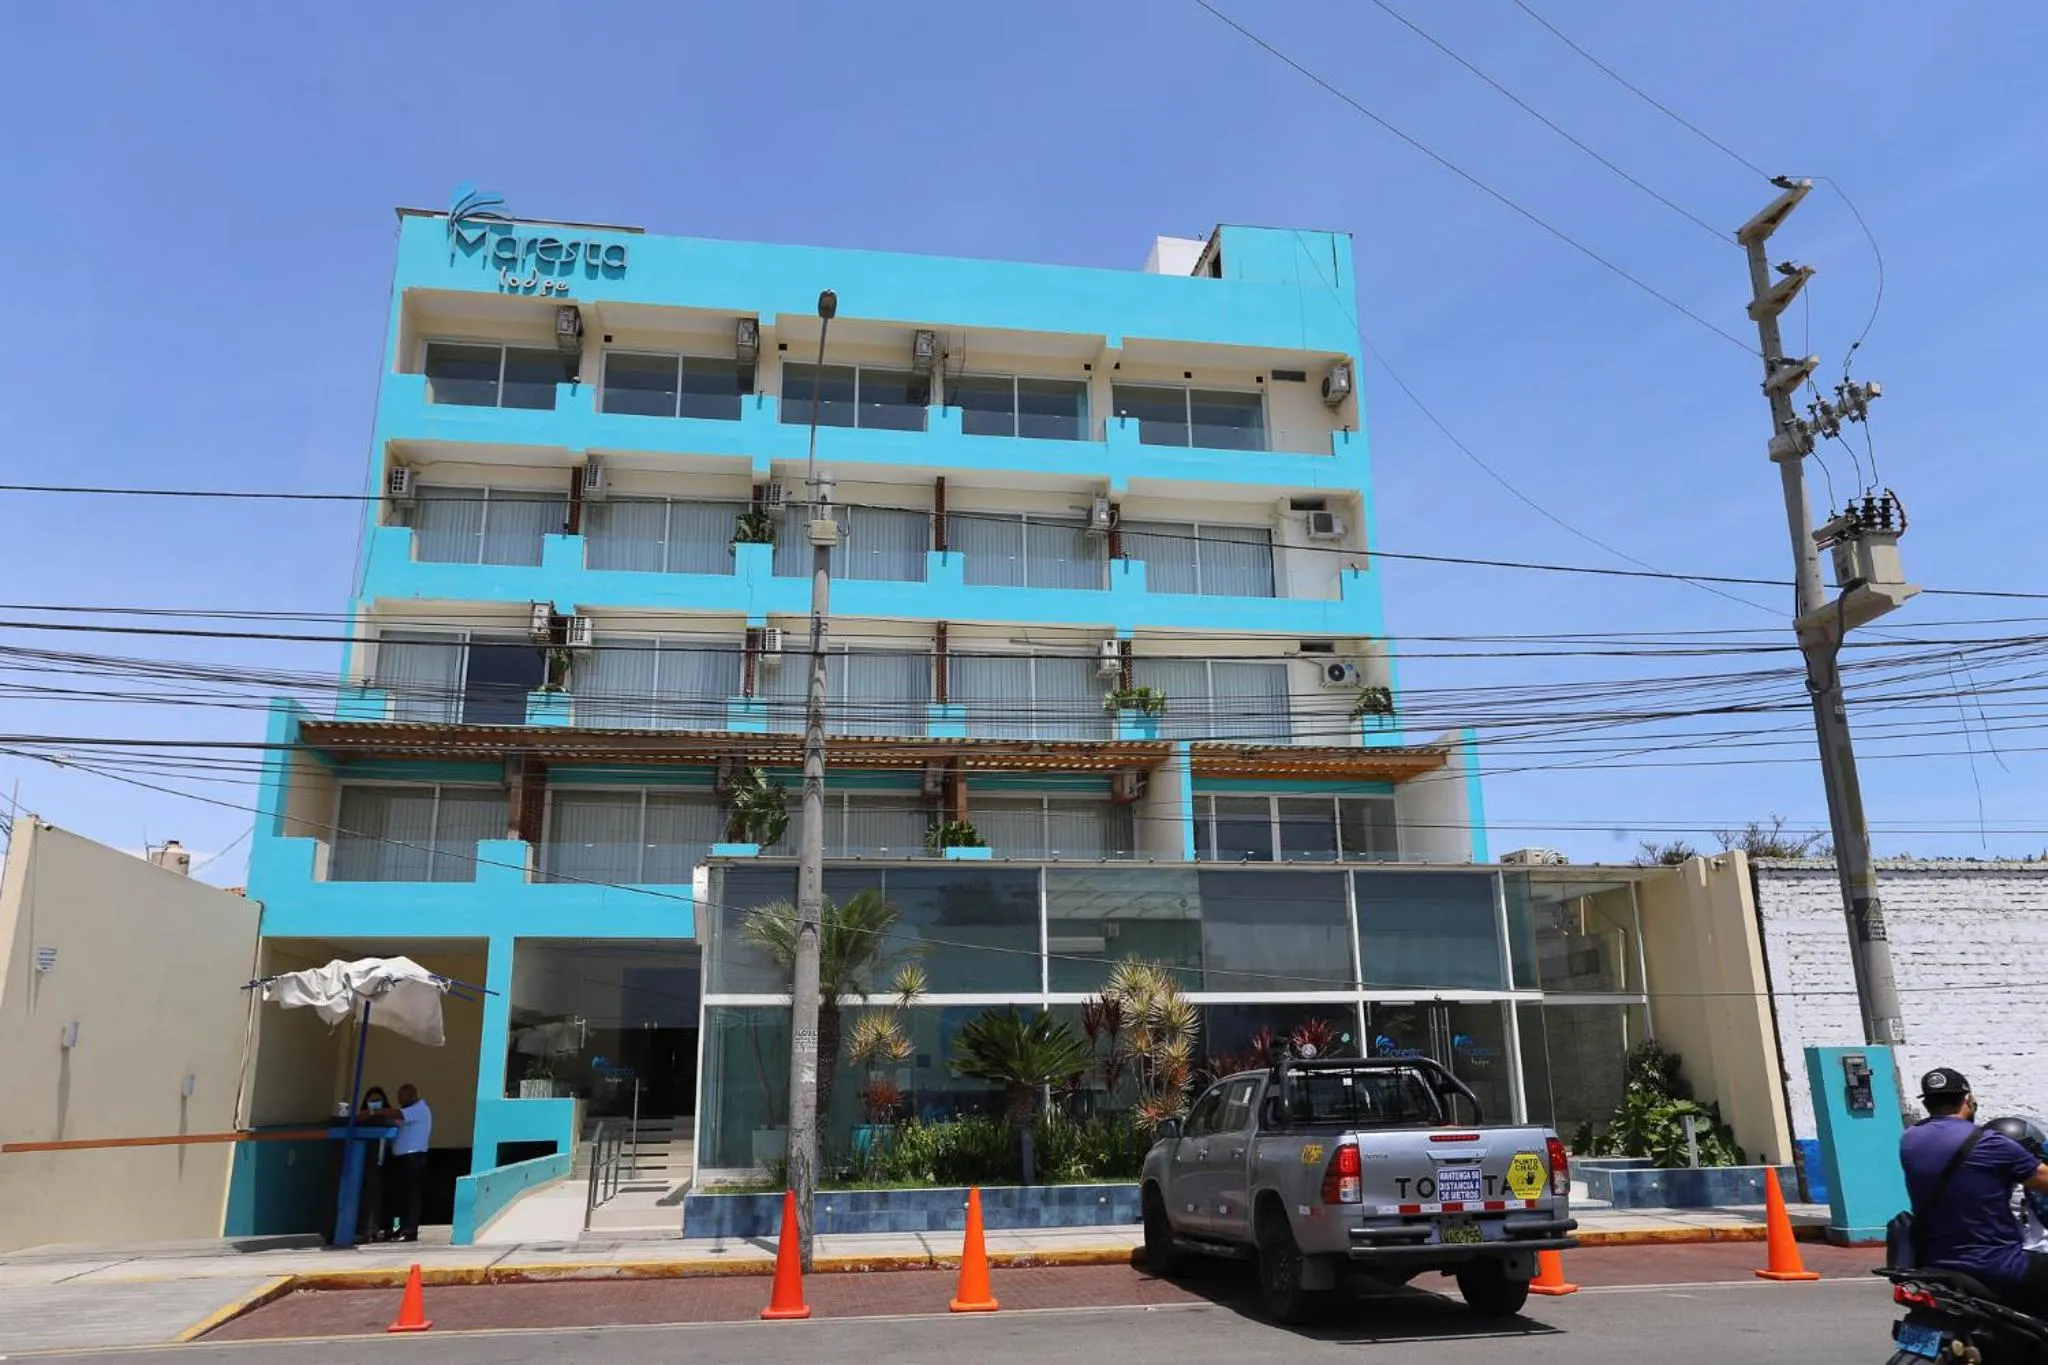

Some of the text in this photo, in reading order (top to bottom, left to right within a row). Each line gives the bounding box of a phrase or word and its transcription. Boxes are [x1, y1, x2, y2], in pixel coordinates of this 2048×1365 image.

[451, 222, 628, 269] Maresta
[1440, 1181, 1474, 1191] DISTANCIA
[1451, 1190, 1480, 1200] METROS
